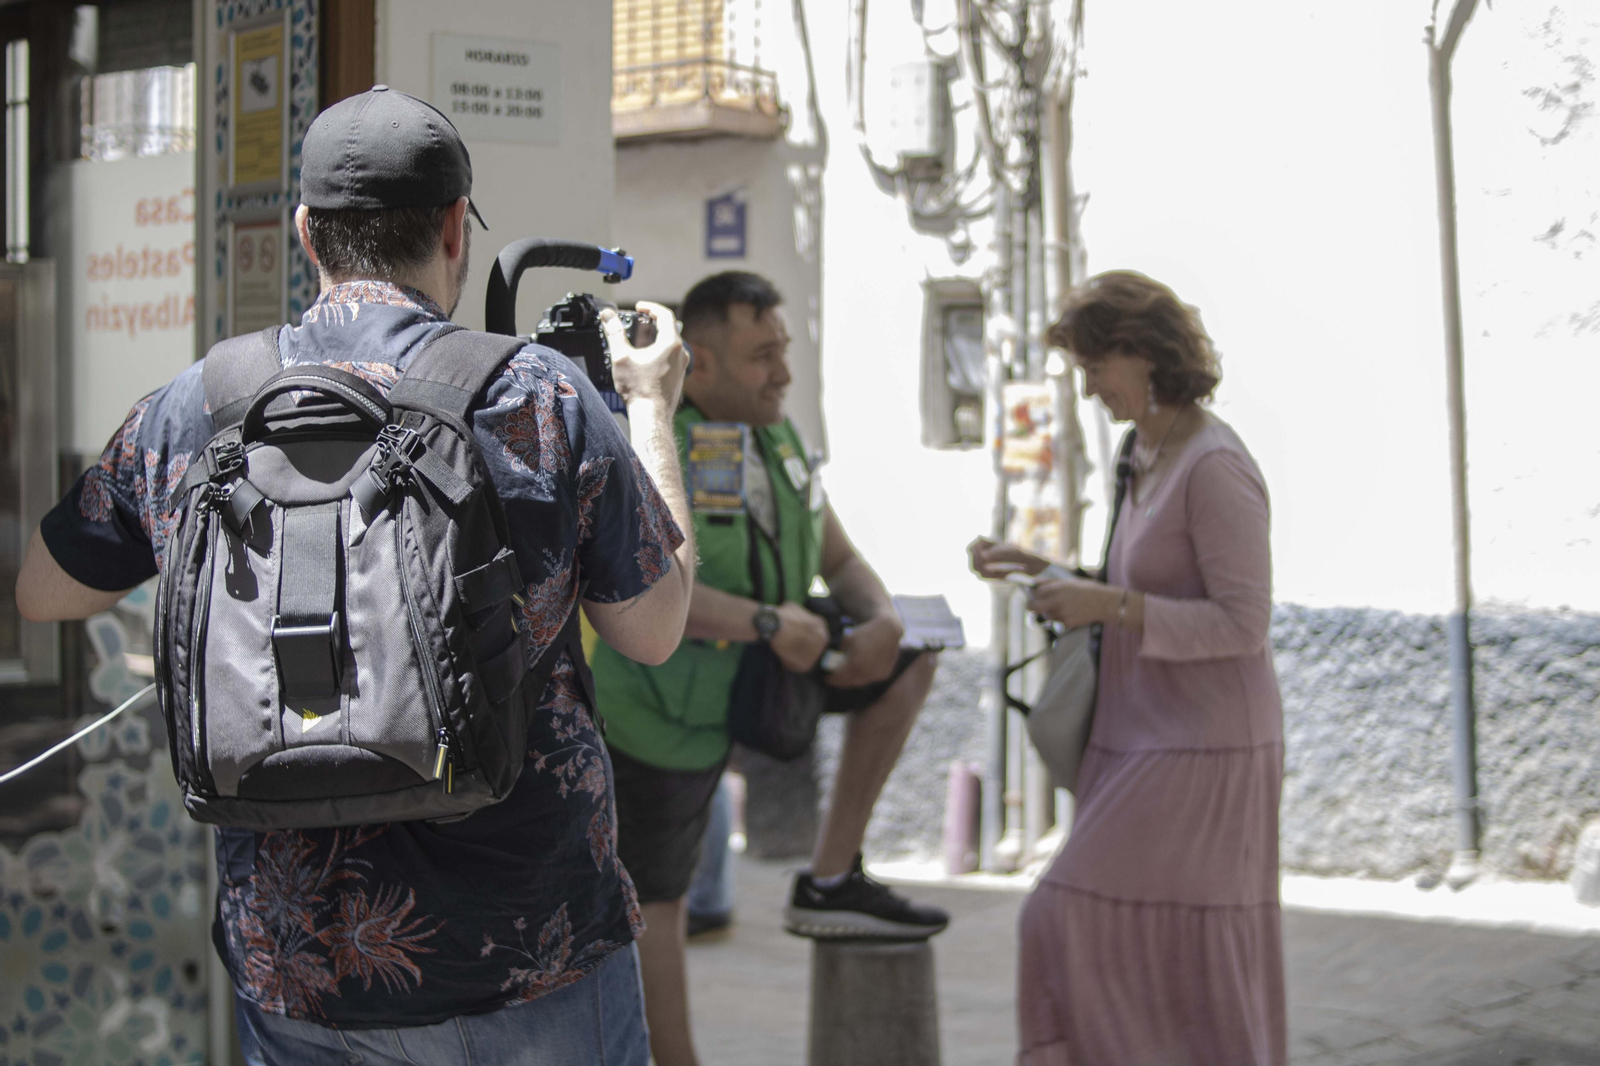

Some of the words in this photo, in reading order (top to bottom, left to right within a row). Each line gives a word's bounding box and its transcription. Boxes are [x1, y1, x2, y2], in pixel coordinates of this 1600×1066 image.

[465, 50, 530, 66] HORARIO
[493, 87, 502, 98] a
[506, 87, 543, 102] 13:00
[493, 105, 502, 116] a
[506, 105, 543, 119] 20:00
